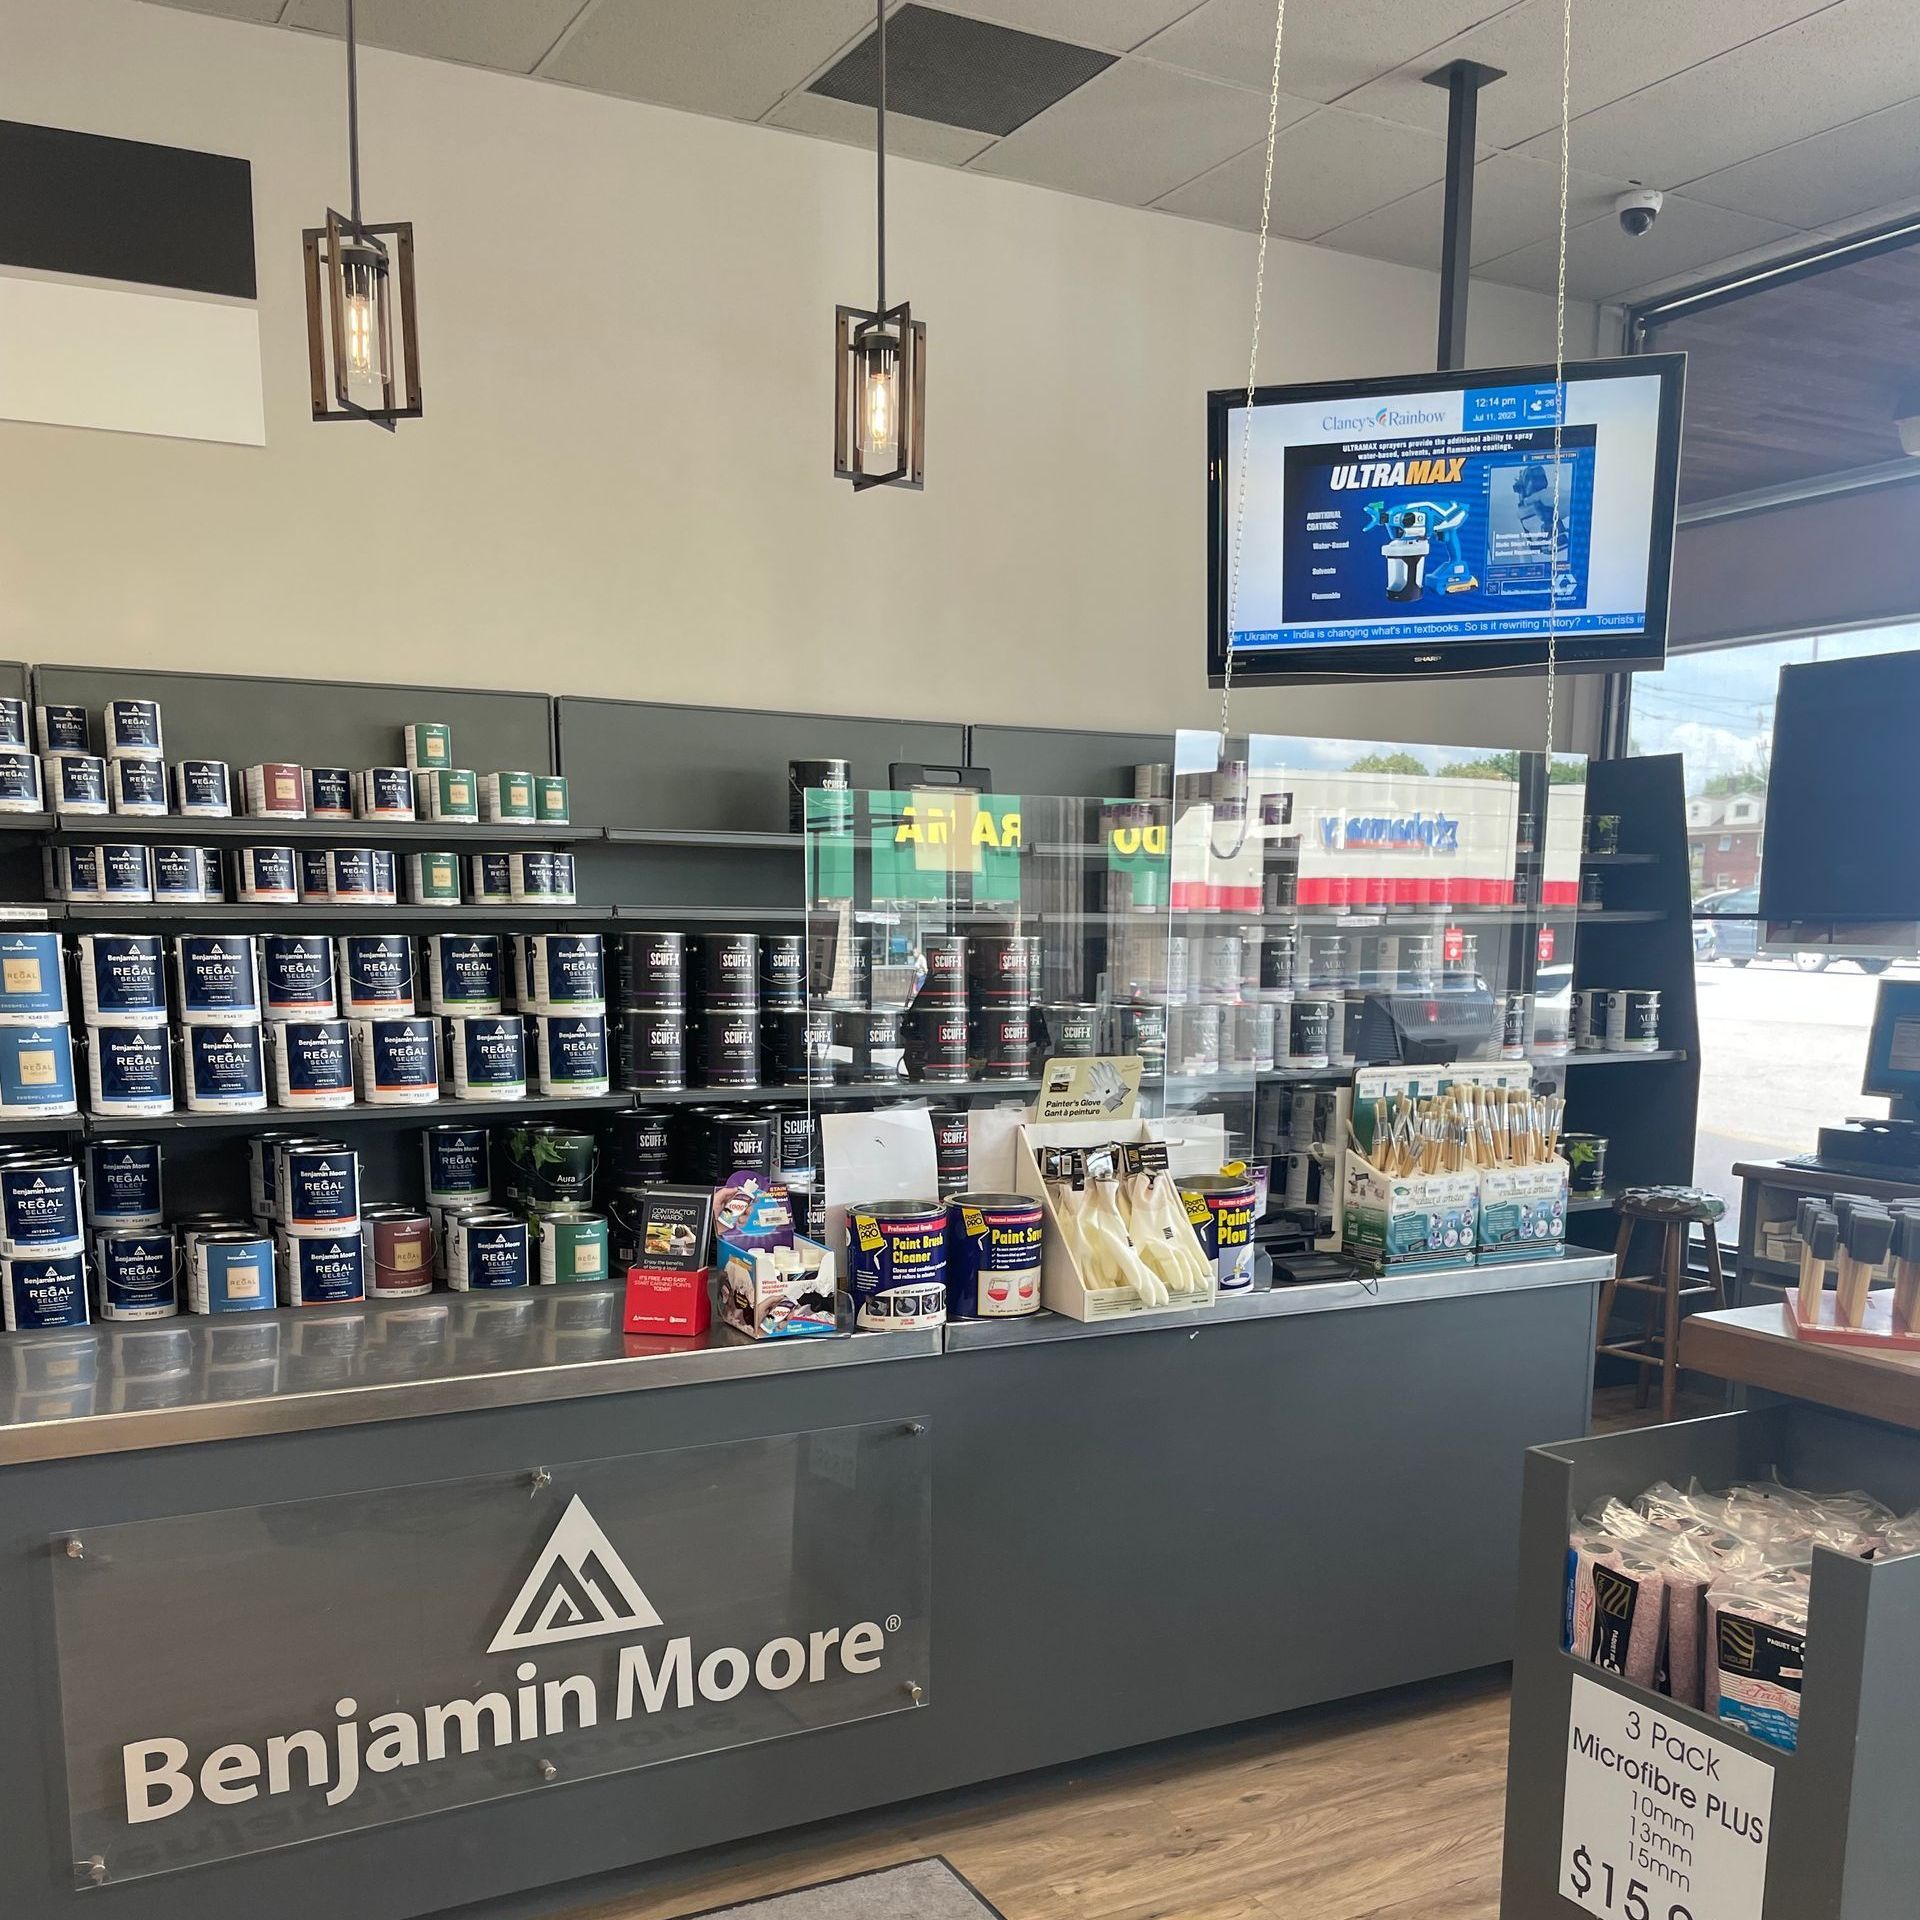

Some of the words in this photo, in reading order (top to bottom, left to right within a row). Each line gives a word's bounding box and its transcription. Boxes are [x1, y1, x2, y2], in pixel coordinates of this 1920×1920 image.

[1475, 397, 1499, 408] 12:14
[1501, 397, 1516, 407] pm
[1322, 415, 1375, 433] Clancy's
[1388, 410, 1446, 426] Rainbow
[1473, 413, 1484, 422] Jul
[1497, 411, 1517, 420] 2023
[1342, 443, 1378, 453] ULTRAMAX
[1379, 441, 1407, 451] sprayers
[1408, 439, 1433, 448] provide
[1434, 438, 1446, 446] the
[1447, 435, 1481, 445] additional
[1482, 434, 1504, 443] ability
[1505, 433, 1513, 441] to
[1514, 432, 1534, 442] spray
[1432, 447, 1445, 455] and
[1446, 445, 1481, 454] flammable
[1329, 456, 1467, 491] ULTRAMAX
[1306, 510, 1342, 521] ADDITIONAL
[1244, 632, 1279, 642] Ukraine
[1293, 630, 1315, 639] India
[1317, 629, 1325, 639] is
[1327, 627, 1369, 640] changing
[1371, 625, 1401, 636] what's
[1403, 624, 1412, 634] in
[1414, 622, 1462, 634] textbooks.
[1464, 622, 1477, 631] So
[1480, 621, 1489, 631] is
[1491, 620, 1497, 630] it
[1499, 619, 1540, 632] rewriting
[1597, 614, 1635, 626] Tourists
[121, 718, 150, 726] REGAL
[70, 774, 99, 782] REGAL
[161, 864, 189, 872] REGAL
[108, 954, 139, 962] Benjamin
[650, 951, 680, 967] SCUFF-X
[722, 952, 752, 968] SCUFF-X
[772, 952, 801, 968] SCUFF-X
[933, 953, 962, 968] SCUFF-X
[1001, 953, 1028, 969] SCUFF-X
[113, 965, 155, 976] REGAL
[197, 965, 239, 975] REGAL
[280, 963, 320, 974] REGAL
[363, 962, 402, 972] REGAL
[456, 962, 492, 972] REGAL
[563, 962, 598, 971] REGAL
[7, 972, 38, 980] REGAL
[651, 1030, 680, 1045] SCUFF-X
[724, 1029, 753, 1044] SCUFF-X
[869, 1029, 896, 1042] SCUFF-X
[941, 1027, 968, 1041] SCUFF-X
[1003, 1026, 1028, 1040] SCUFF-X
[1063, 1025, 1092, 1039] SCUFF-X
[389, 1047, 428, 1057] REGAL
[481, 1045, 517, 1054] REGAL
[563, 1042, 599, 1051] REGAL
[117, 1055, 160, 1065] REGAL
[208, 1053, 250, 1064] REGAL
[303, 1050, 343, 1060] REGAL
[22, 1063, 54, 1072] REGAL
[1045, 1099, 1080, 1109] Painter's
[1080, 1098, 1102, 1107] Glove
[1044, 1109, 1062, 1117] Gant
[1063, 1108, 1069, 1117] à
[1069, 1108, 1101, 1118] peinture
[639, 1134, 667, 1149] SCUFF-X
[733, 1140, 763, 1156] SCUFF-X
[442, 1156, 478, 1165] REGAL
[107, 1174, 149, 1184] REGAL
[556, 1174, 576, 1184] Aura
[12, 1187, 44, 1196] Benjamin
[44, 1186, 66, 1195] Moore
[304, 1181, 345, 1191] REGAL
[18, 1198, 64, 1210] REGAL
[1186, 1203, 1206, 1215] PRO
[25, 1208, 58, 1216] SELECT
[651, 1206, 697, 1217] CONTRACTOR
[650, 1213, 684, 1222] REWARDS
[807, 1210, 826, 1225] SCUF
[967, 1217, 983, 1228] PRO
[1217, 1208, 1252, 1228] Paint
[861, 1228, 879, 1240] PRO
[991, 1228, 1025, 1245] Paint
[1217, 1226, 1247, 1245] Plow
[893, 1236, 921, 1250] Paint
[922, 1232, 944, 1249] Brush
[482, 1251, 519, 1262] REGAL
[892, 1250, 932, 1264] Cleaner
[119, 1265, 161, 1276] REGAL
[315, 1263, 354, 1274] REGAL
[229, 1278, 257, 1287] REGAL
[29, 1286, 74, 1299] REGAL
[37, 1295, 70, 1304] SELECT
[1767, 1637, 1791, 1650] PAQUET
[121, 1660, 599, 1826] Benjamin
[1624, 1711, 1642, 1741] 3
[1652, 1722, 1721, 1782] Pack
[1572, 1725, 1697, 1810] Microfibre
[1705, 1792, 1765, 1845] PLUS
[1631, 1790, 1695, 1842] 10mm
[1629, 1815, 1693, 1867] 13mm
[1627, 1840, 1691, 1893] 15mm
